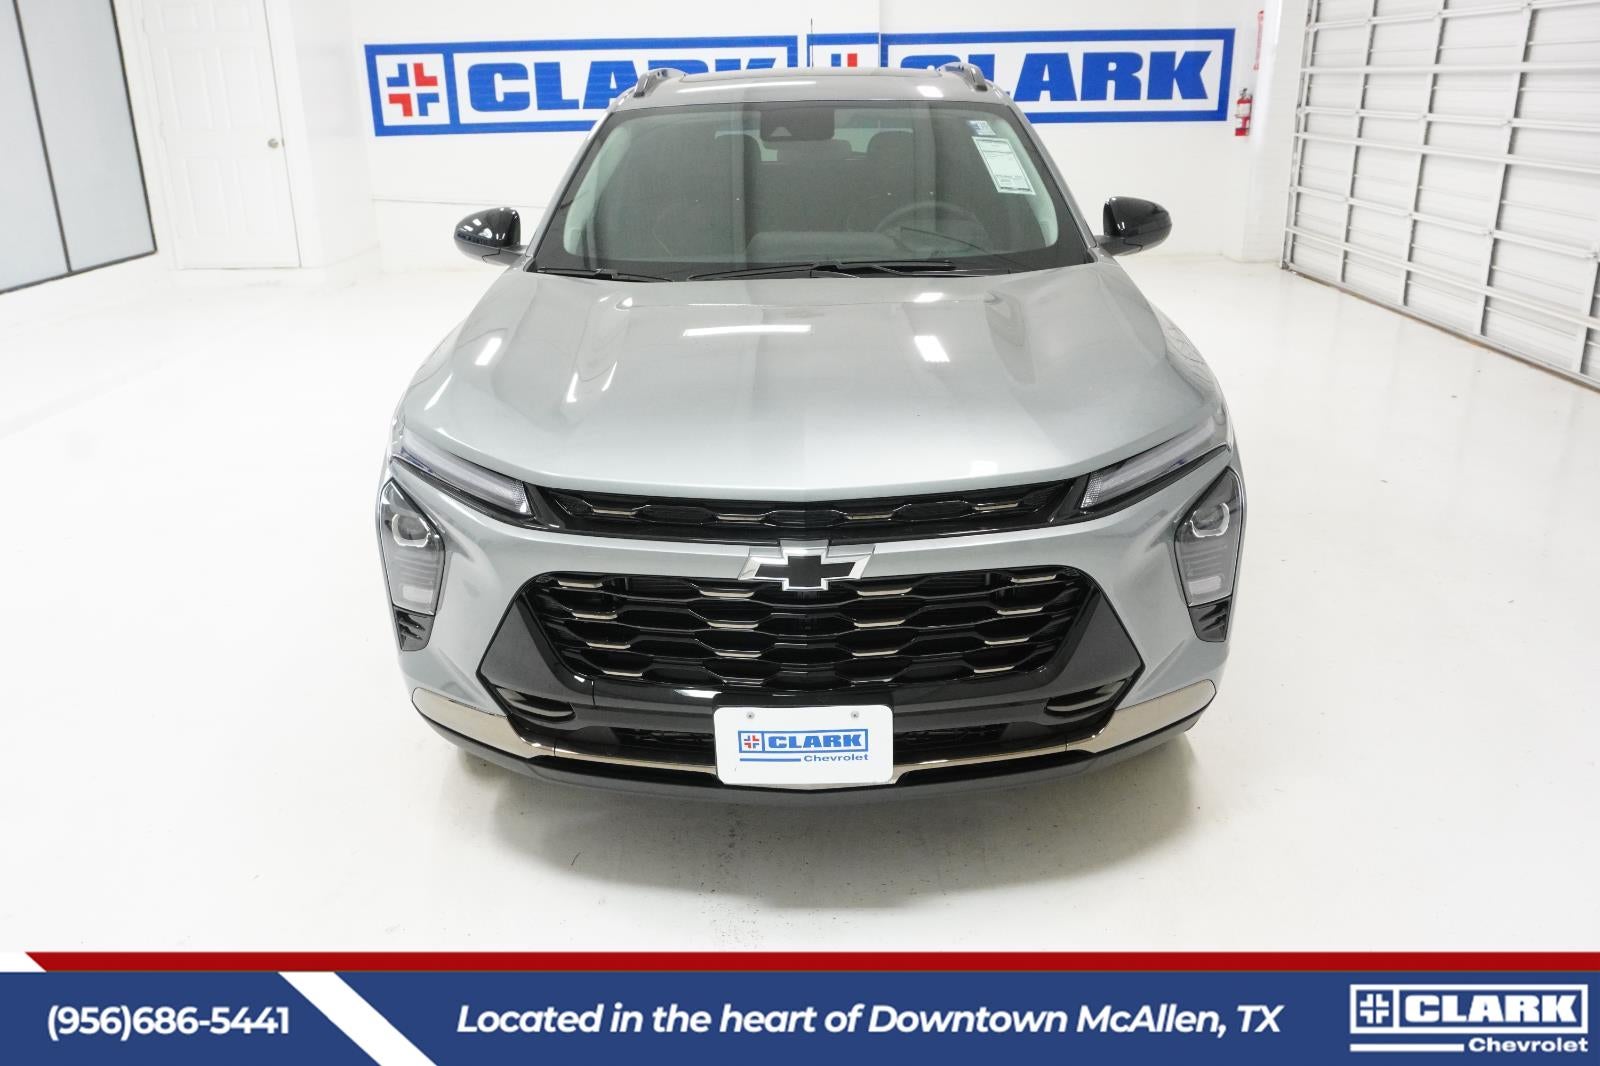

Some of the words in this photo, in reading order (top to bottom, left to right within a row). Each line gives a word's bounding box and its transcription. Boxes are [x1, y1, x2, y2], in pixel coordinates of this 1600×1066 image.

[467, 57, 776, 112] CLA
[900, 51, 1212, 102] ARK
[768, 734, 862, 749] CLARK
[803, 753, 869, 762] Chevrolet
